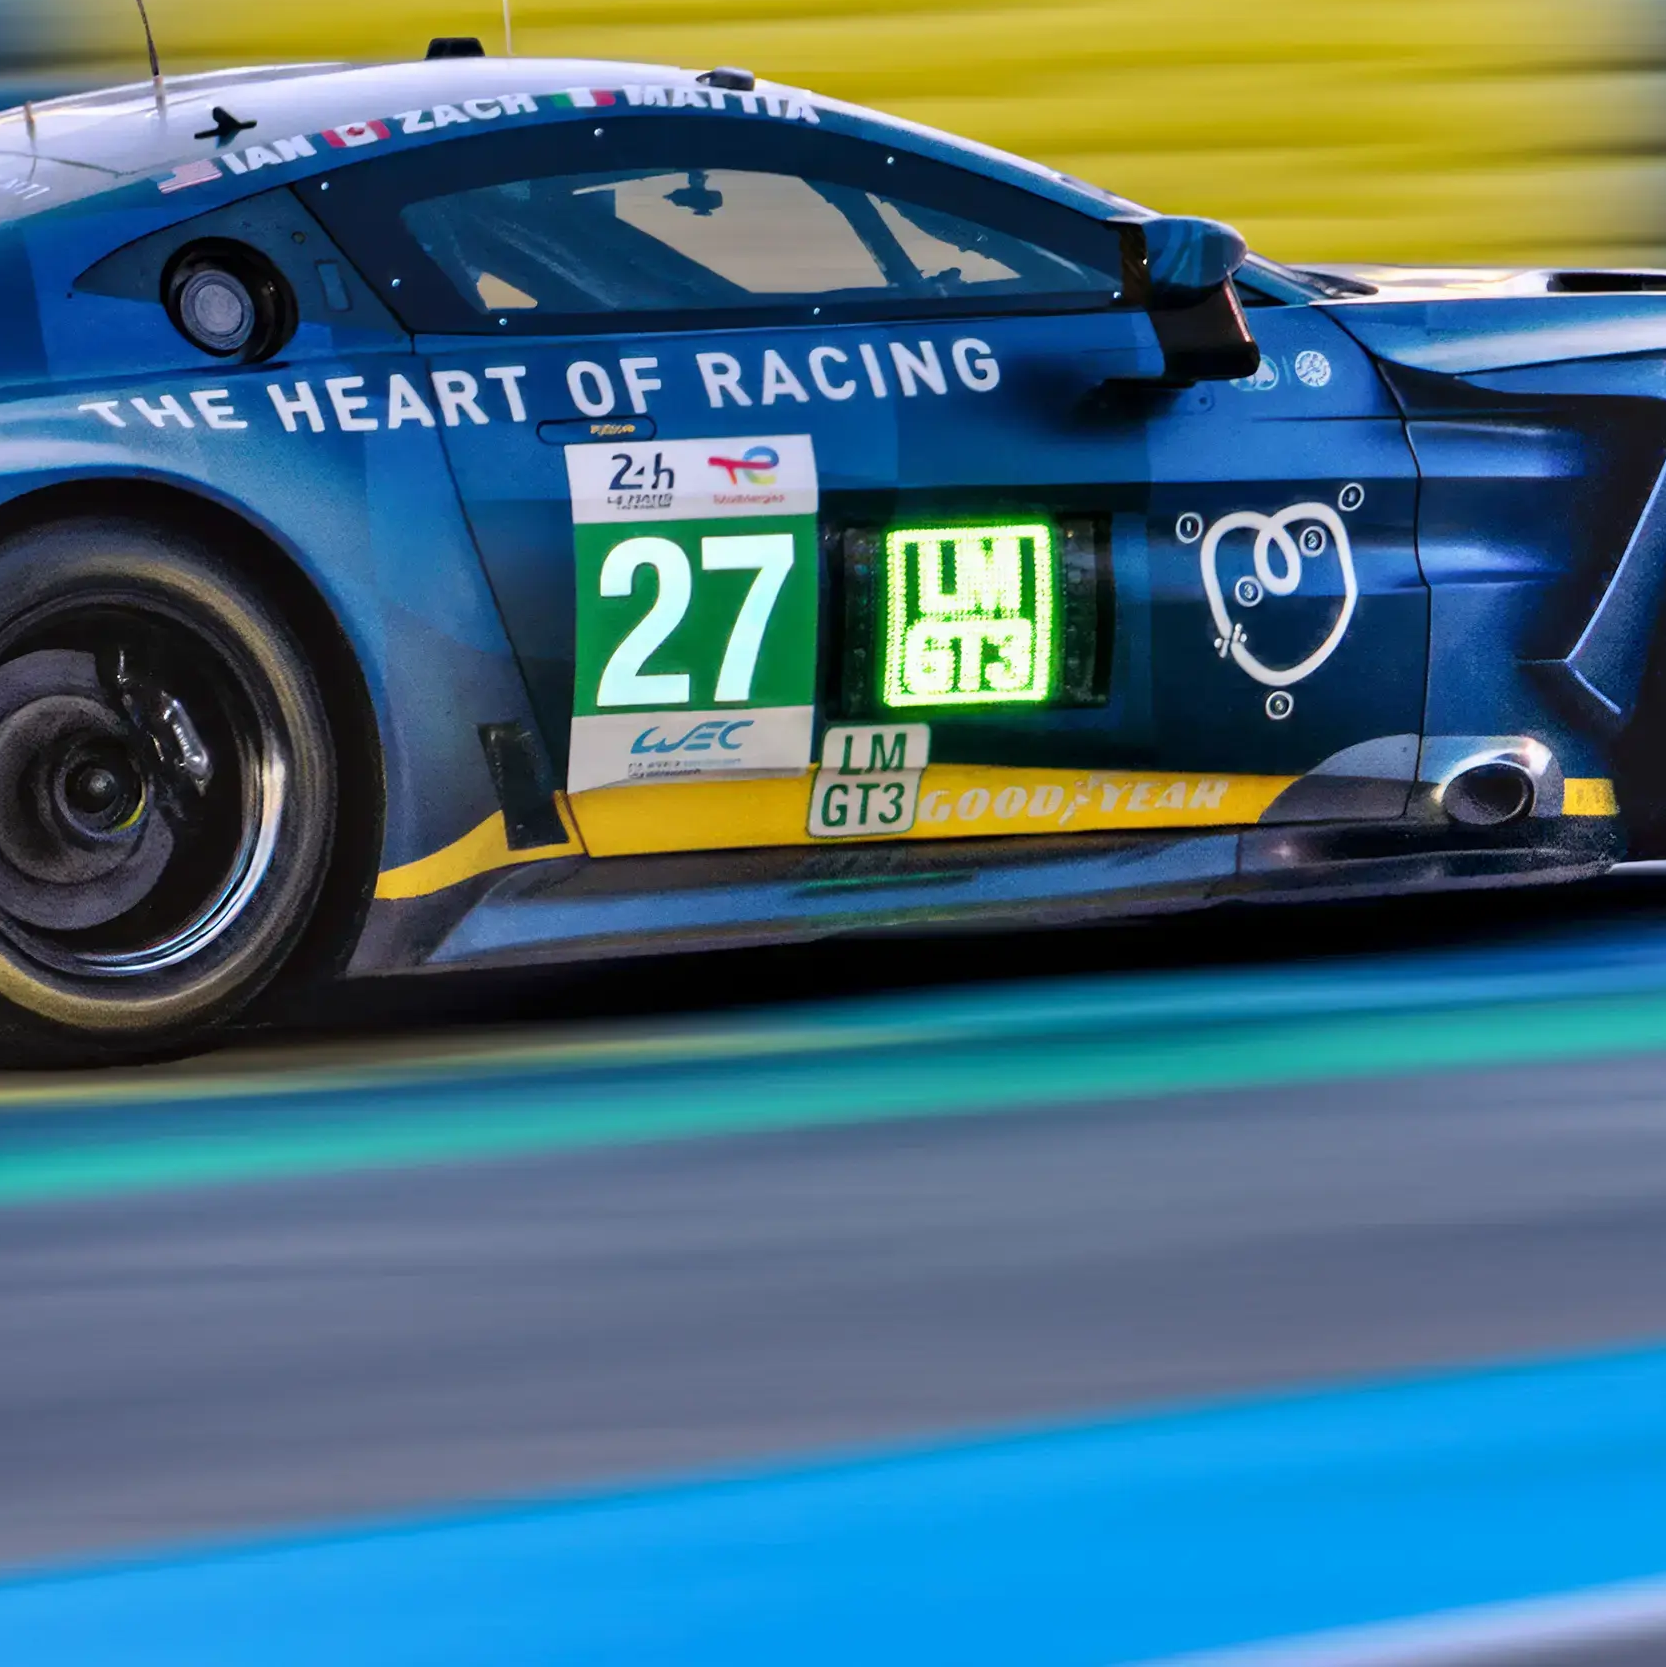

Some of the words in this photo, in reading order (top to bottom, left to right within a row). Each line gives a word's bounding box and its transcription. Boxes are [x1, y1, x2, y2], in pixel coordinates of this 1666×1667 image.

[221, 134, 318, 175] IAN
[394, 92, 538, 135] ZACH
[622, 84, 821, 125] MATTIA
[77, 388, 249, 431] THE
[266, 364, 528, 434] HEART
[565, 355, 663, 418] OF
[695, 336, 1002, 410] RACING
[918, 539, 1022, 616] LM
[596, 533, 795, 708] 27
[903, 620, 1033, 694] GT3
[629, 719, 756, 755] WEC
[836, 731, 907, 777] LM
[820, 781, 906, 828] GT3
